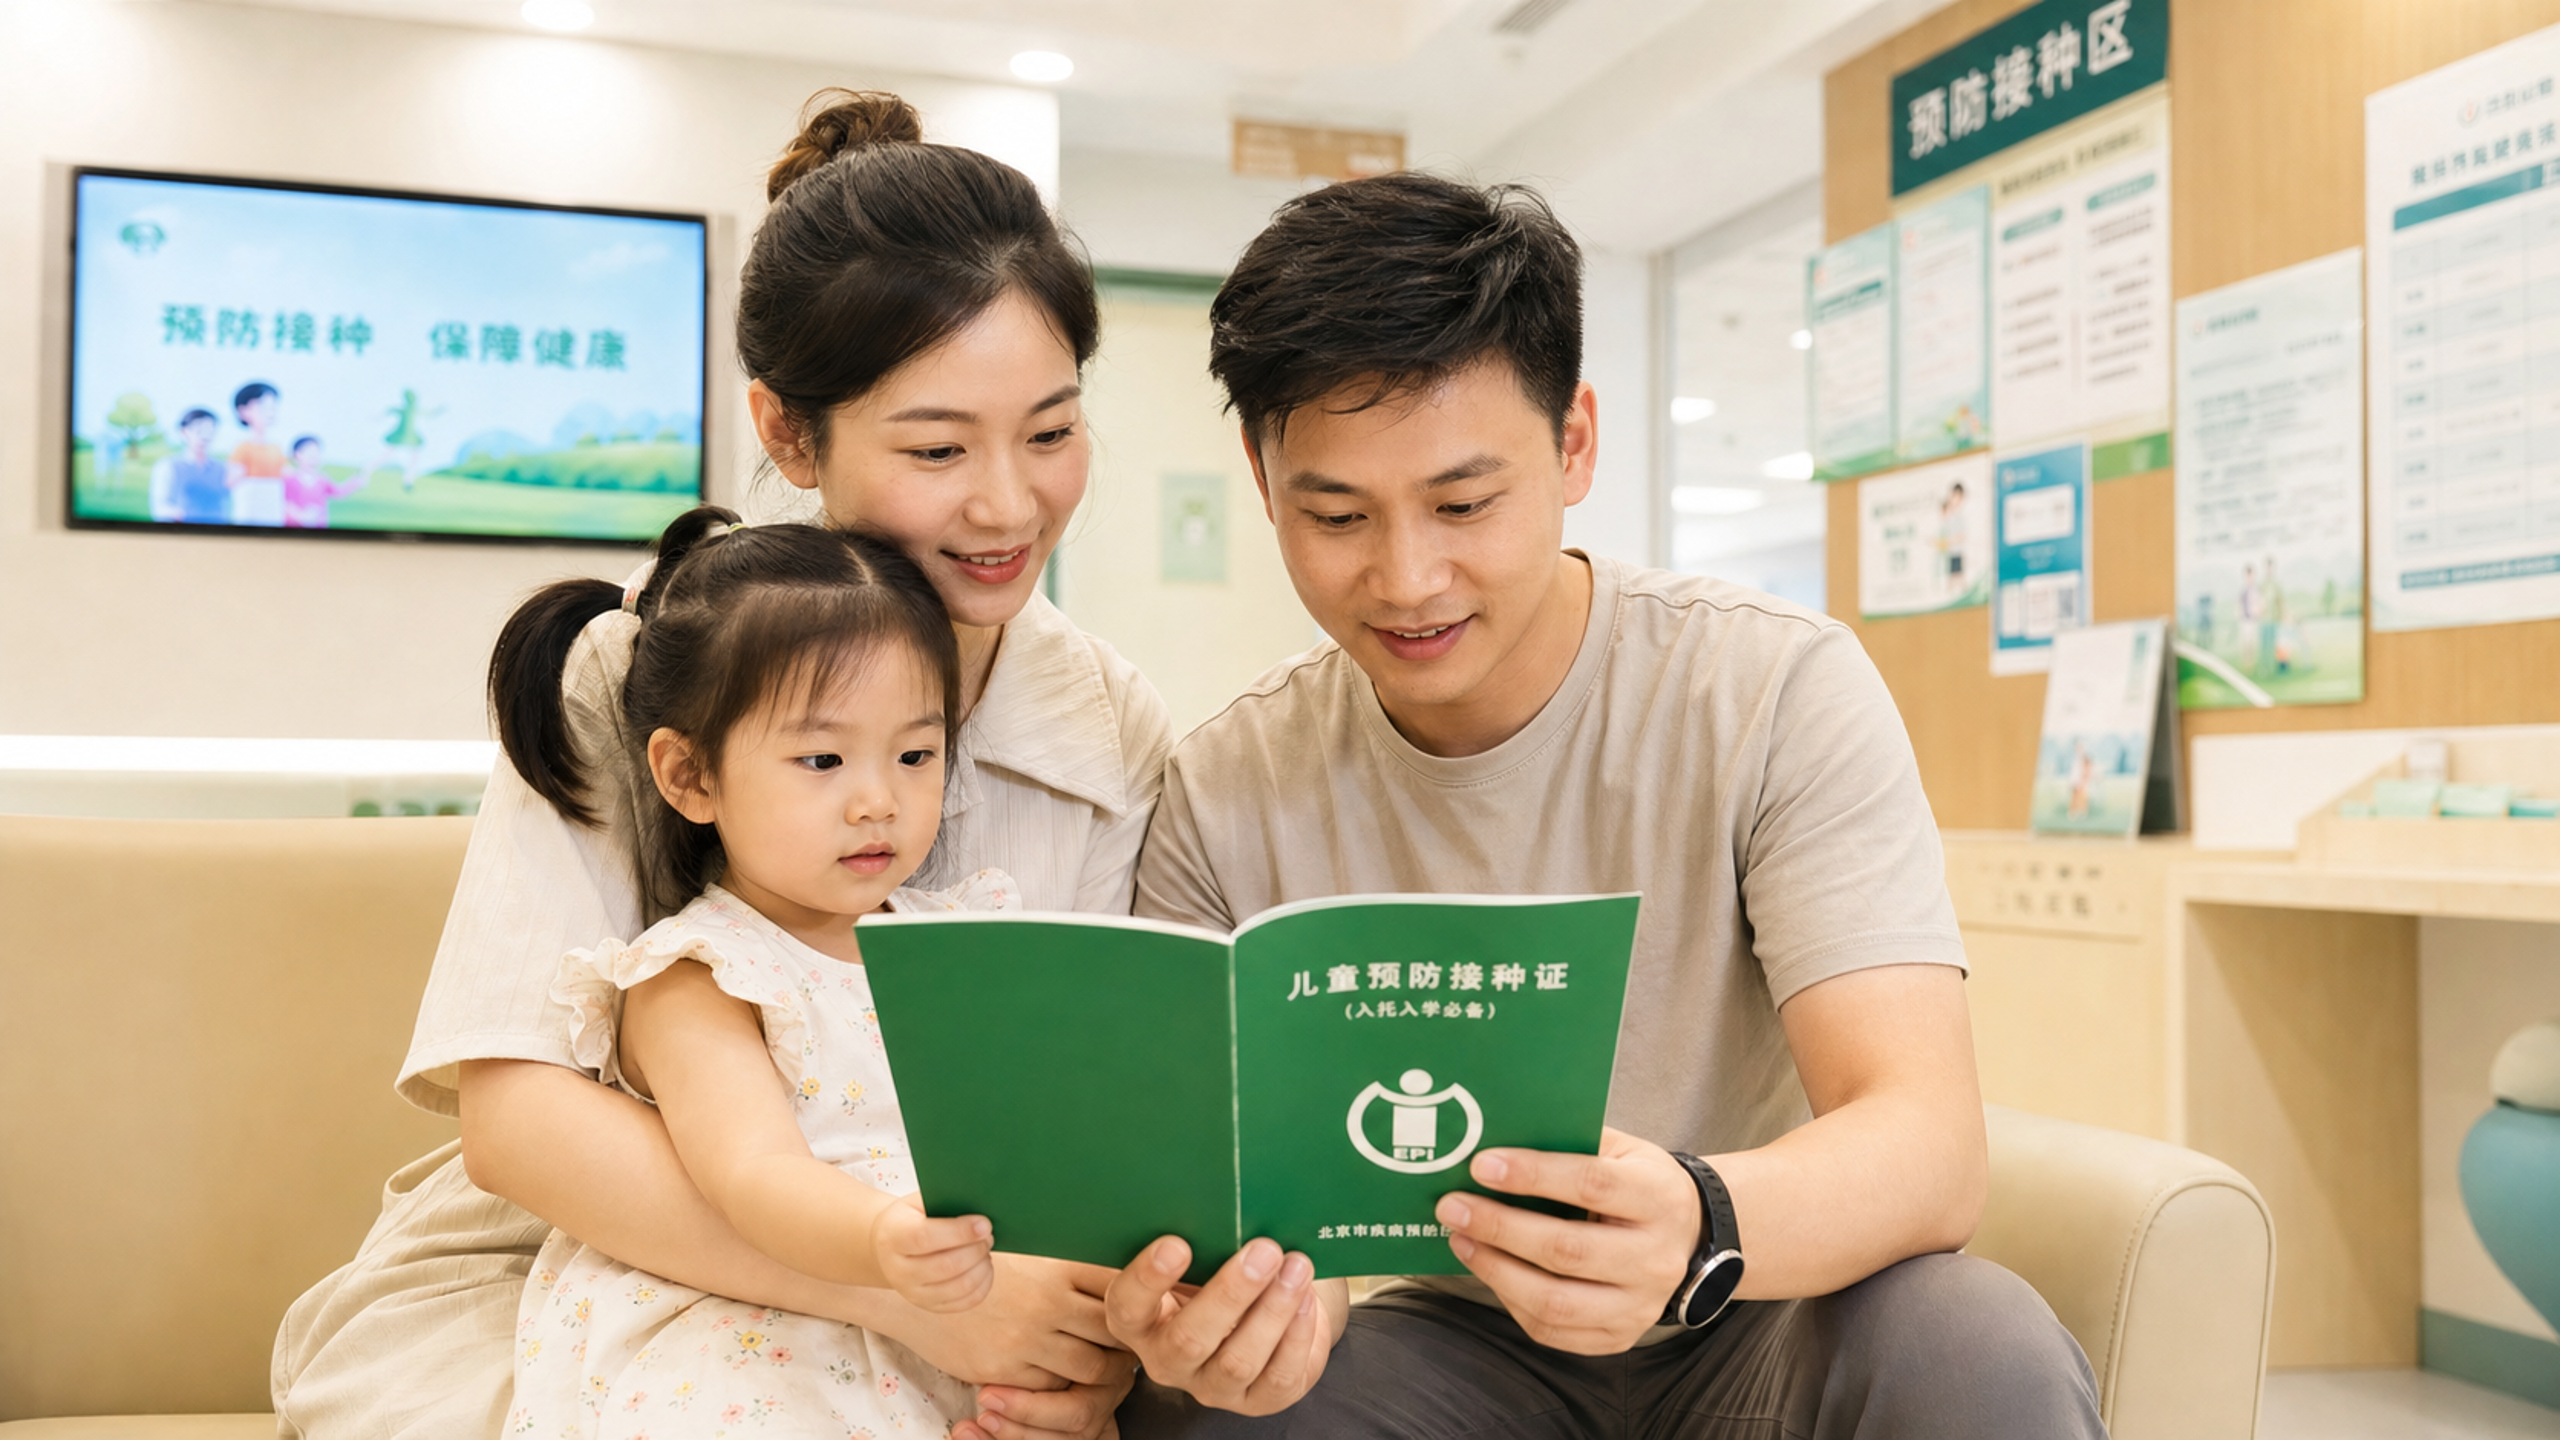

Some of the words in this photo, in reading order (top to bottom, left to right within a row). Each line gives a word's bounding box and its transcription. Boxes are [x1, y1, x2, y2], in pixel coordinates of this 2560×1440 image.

[1906, 0, 2134, 161] 预防接种区
[160, 303, 374, 357] 预防接种
[430, 320, 629, 371] 保障健康
[1287, 961, 1569, 1002] 儿童预防接种证
[1393, 1147, 1436, 1161] EPI
